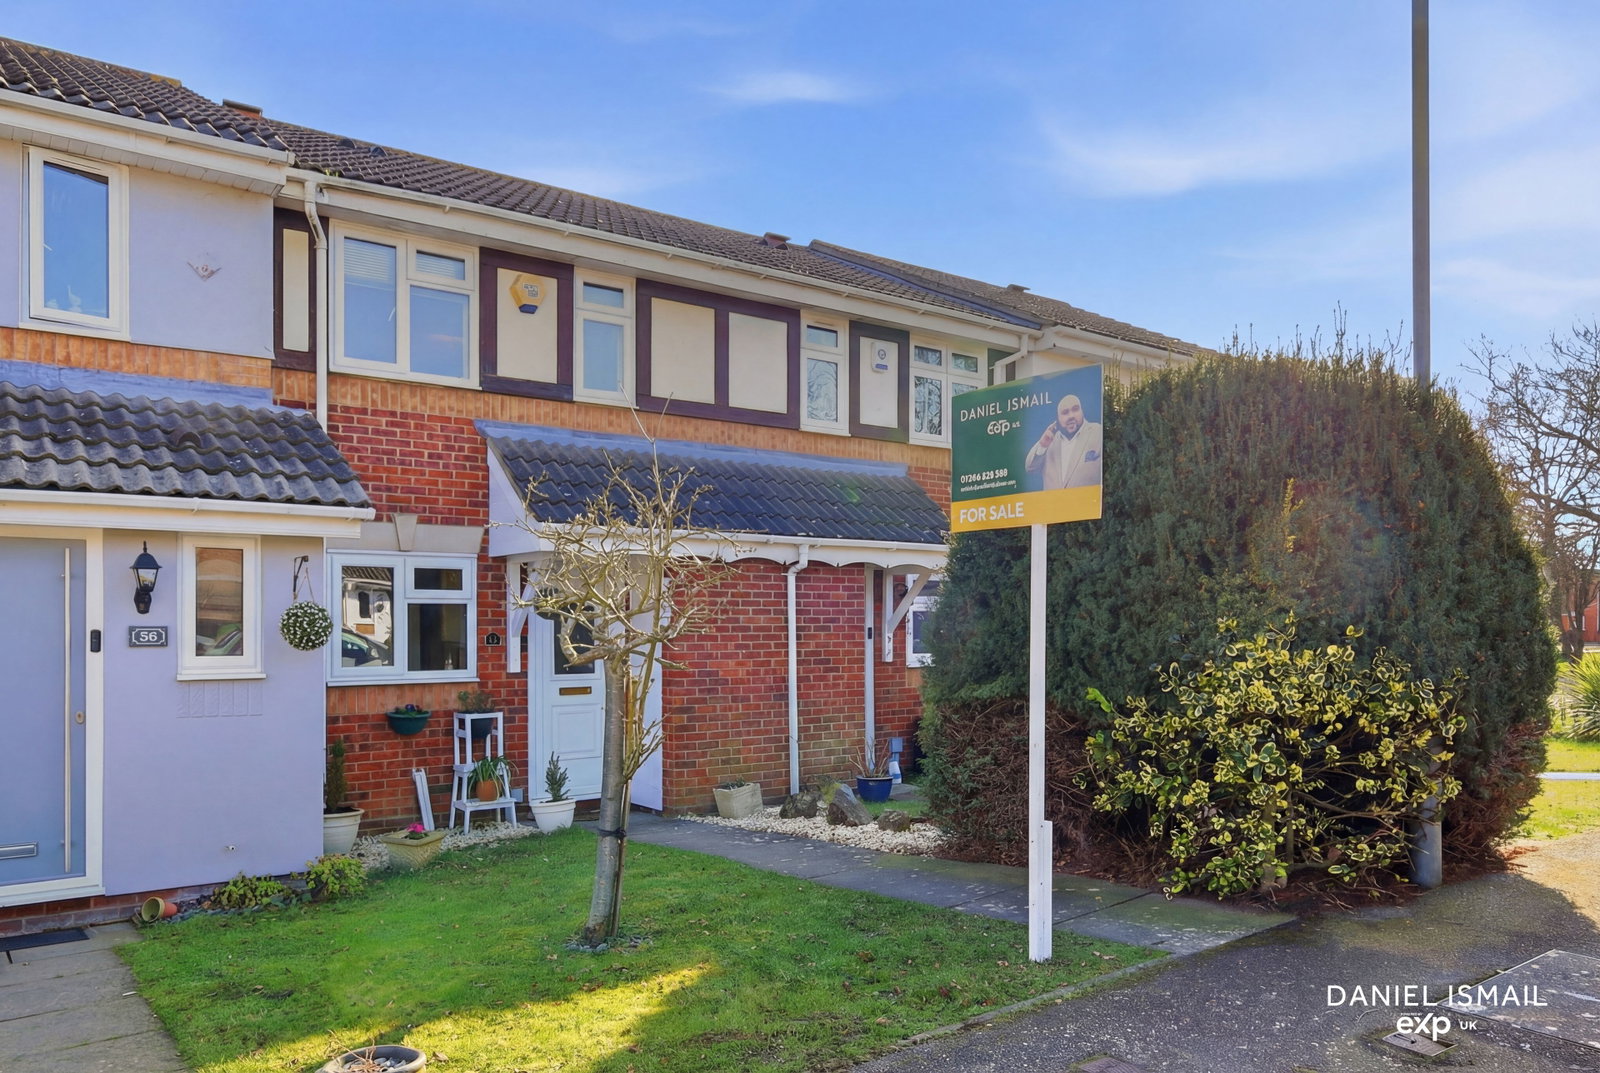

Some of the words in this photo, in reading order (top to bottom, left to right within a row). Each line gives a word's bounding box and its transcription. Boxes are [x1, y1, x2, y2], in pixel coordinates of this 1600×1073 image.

[960, 402, 1003, 422] DANIEL
[1007, 392, 1053, 412] ISMAIL
[959, 506, 987, 524] FOR
[989, 502, 1025, 521] SALE
[139, 631, 158, 642] 56
